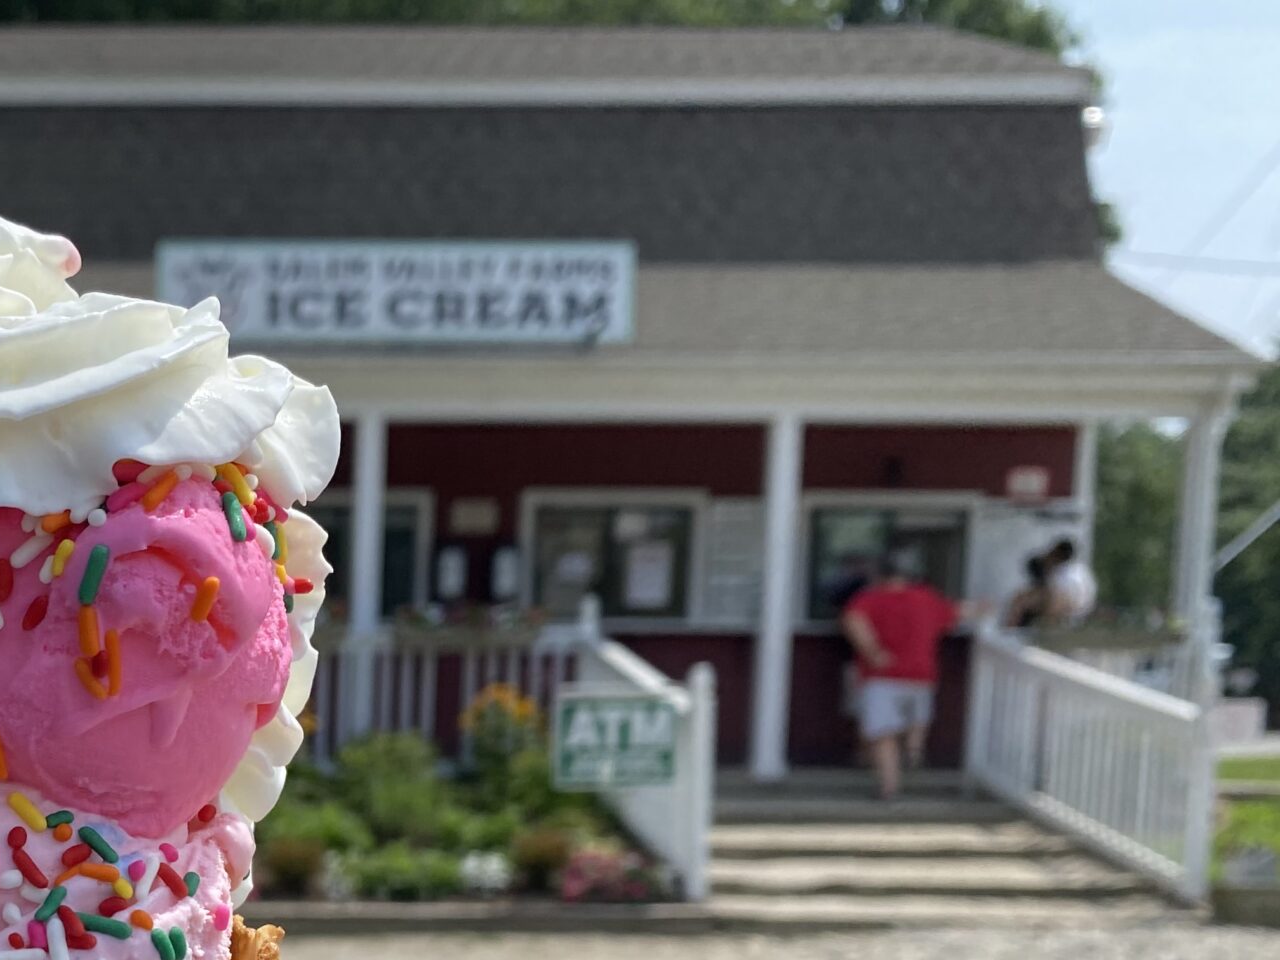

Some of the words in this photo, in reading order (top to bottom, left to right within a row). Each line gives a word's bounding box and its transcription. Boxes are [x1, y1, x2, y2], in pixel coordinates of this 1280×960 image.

[266, 289, 370, 330] ICE
[384, 289, 611, 330] CREAM
[565, 708, 673, 746] ATM
